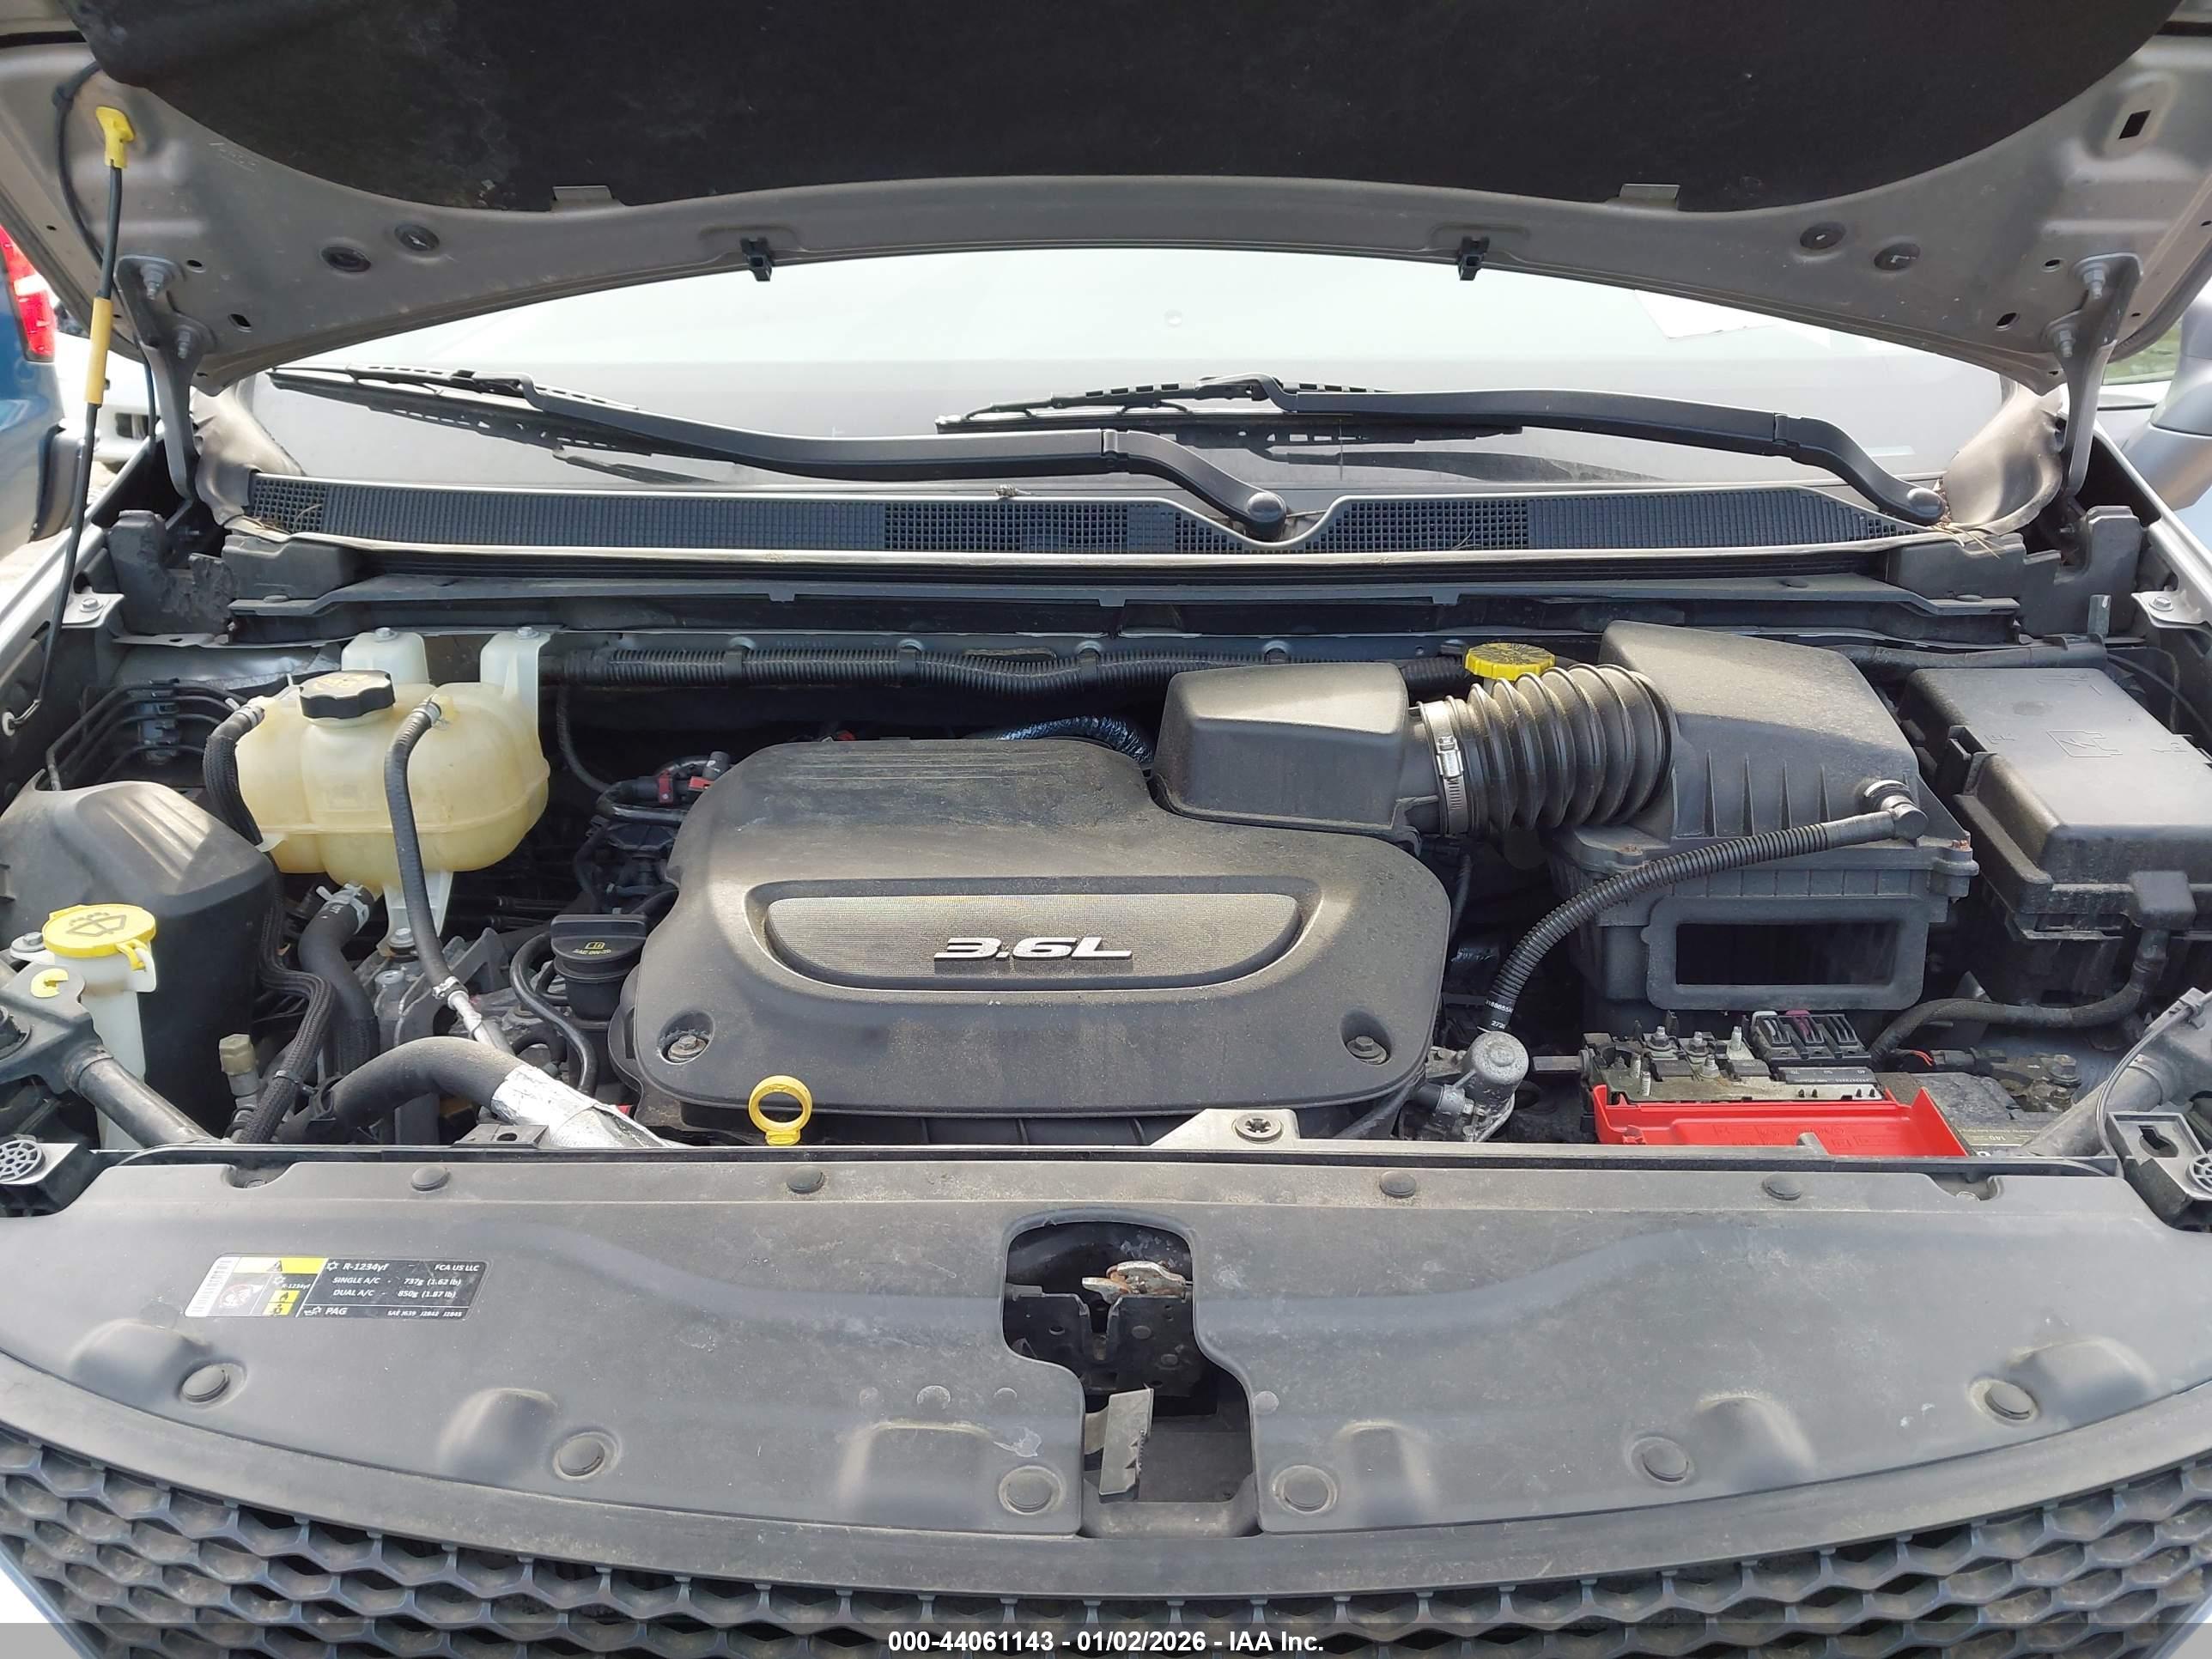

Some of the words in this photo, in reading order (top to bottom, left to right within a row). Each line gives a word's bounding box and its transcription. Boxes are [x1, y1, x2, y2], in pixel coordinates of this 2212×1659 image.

[933, 937, 1133, 960] 3.6L
[343, 1262, 390, 1272] R-1234yf
[404, 1278, 425, 1286] 737g
[325, 1307, 349, 1316] PAG
